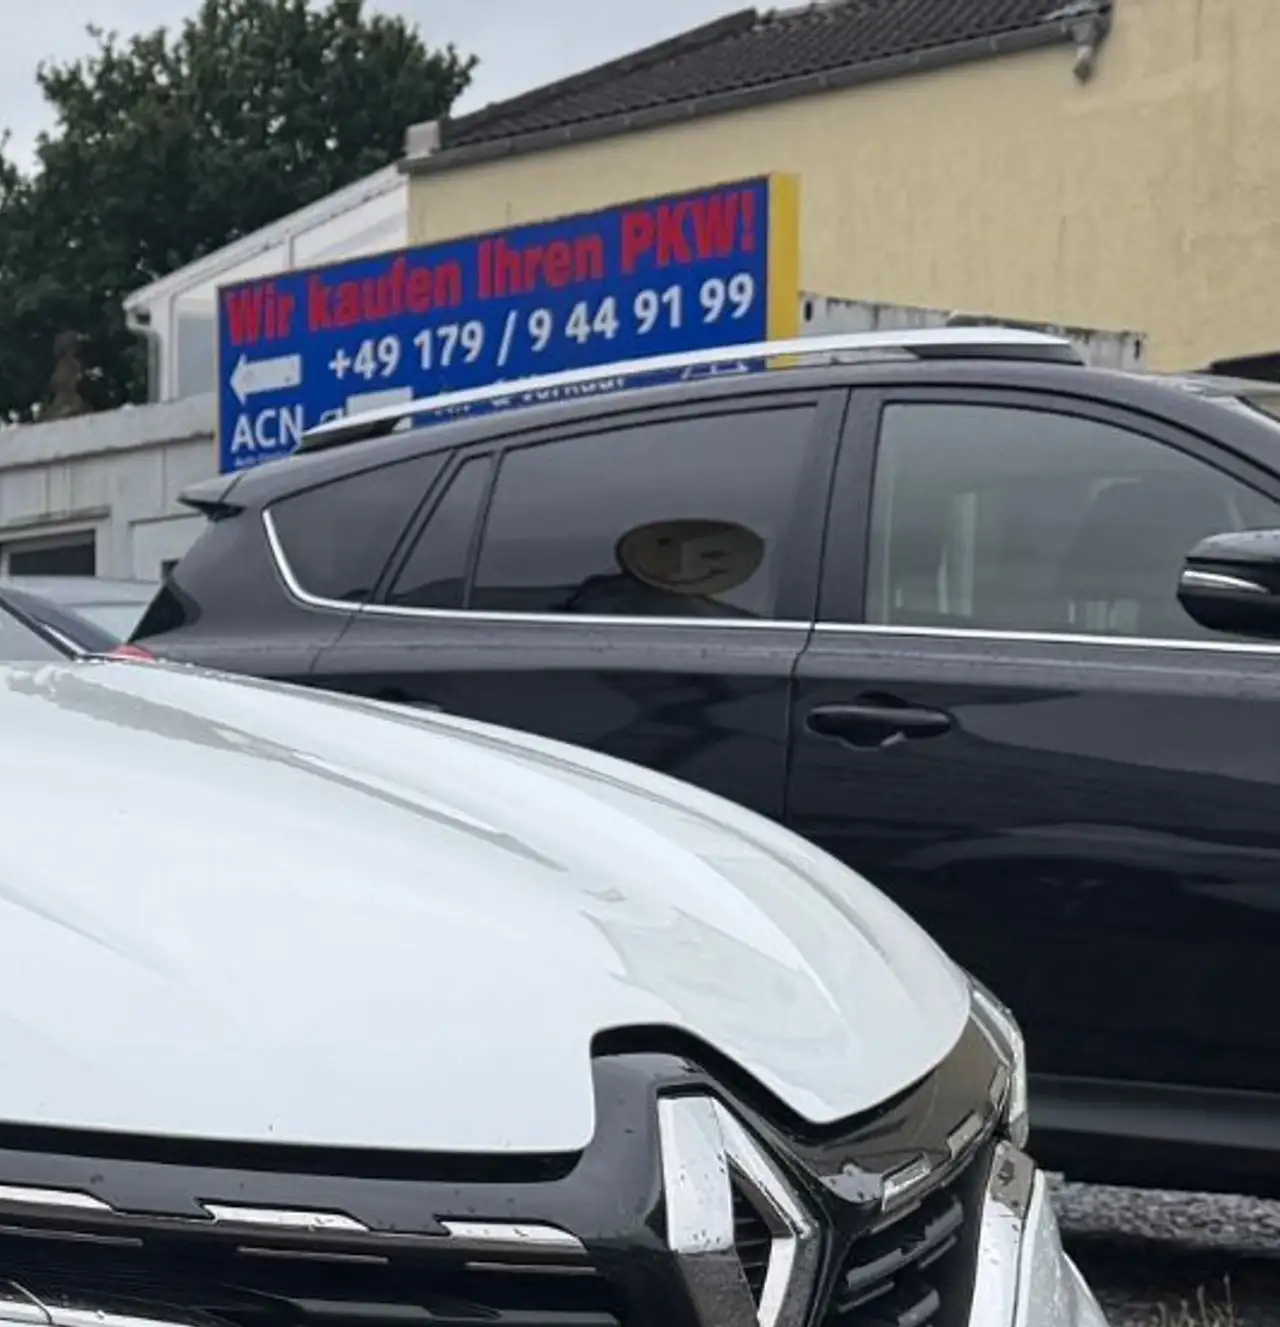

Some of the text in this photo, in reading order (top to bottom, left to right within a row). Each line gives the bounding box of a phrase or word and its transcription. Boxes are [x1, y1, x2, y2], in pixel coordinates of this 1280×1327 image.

[227, 190, 755, 346] Wir kaufen Ihren PKW!
[328, 334, 401, 380] +49
[413, 319, 484, 370] 179
[528, 308, 553, 352] 9
[564, 296, 620, 343] 44
[633, 284, 683, 335] 91
[699, 272, 755, 324] 99
[230, 403, 304, 453] ACN
